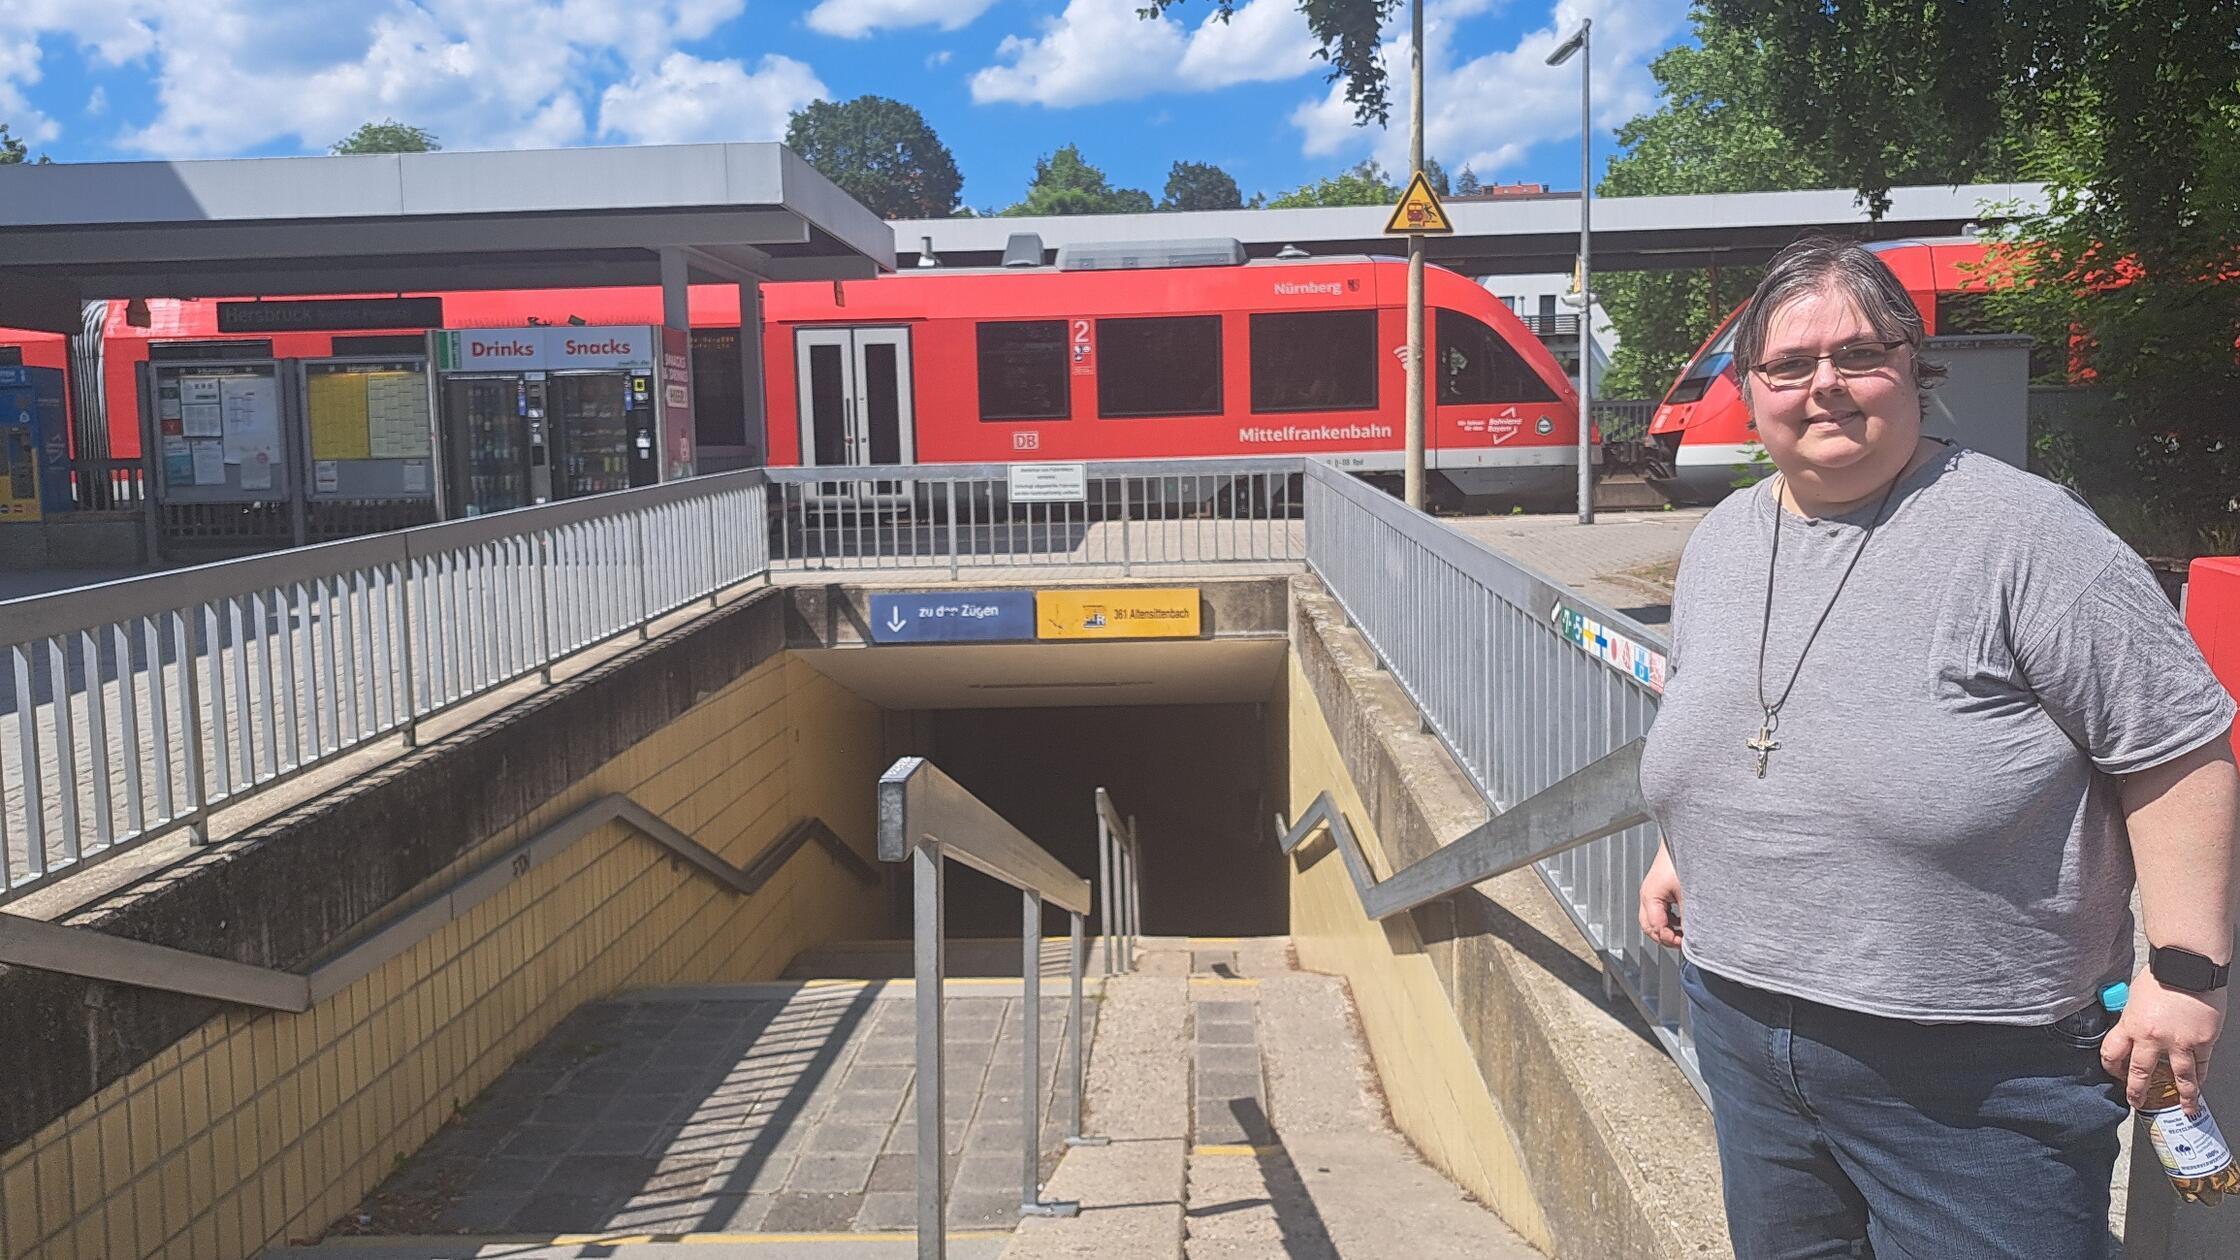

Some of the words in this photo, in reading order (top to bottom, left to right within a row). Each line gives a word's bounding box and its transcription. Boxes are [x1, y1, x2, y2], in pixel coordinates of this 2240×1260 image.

[1274, 281, 1342, 296] Nürnberg
[1074, 320, 1089, 343] 2
[471, 341, 534, 357] Drinks
[565, 339, 631, 355] Snacks
[1238, 423, 1392, 442] Mittelfrankenbahn
[1016, 434, 1037, 448] DB
[919, 607, 933, 617] zu
[961, 604, 999, 619] Zügen
[1114, 609, 1127, 620] 361
[1129, 607, 1190, 620] Altensittenbach
